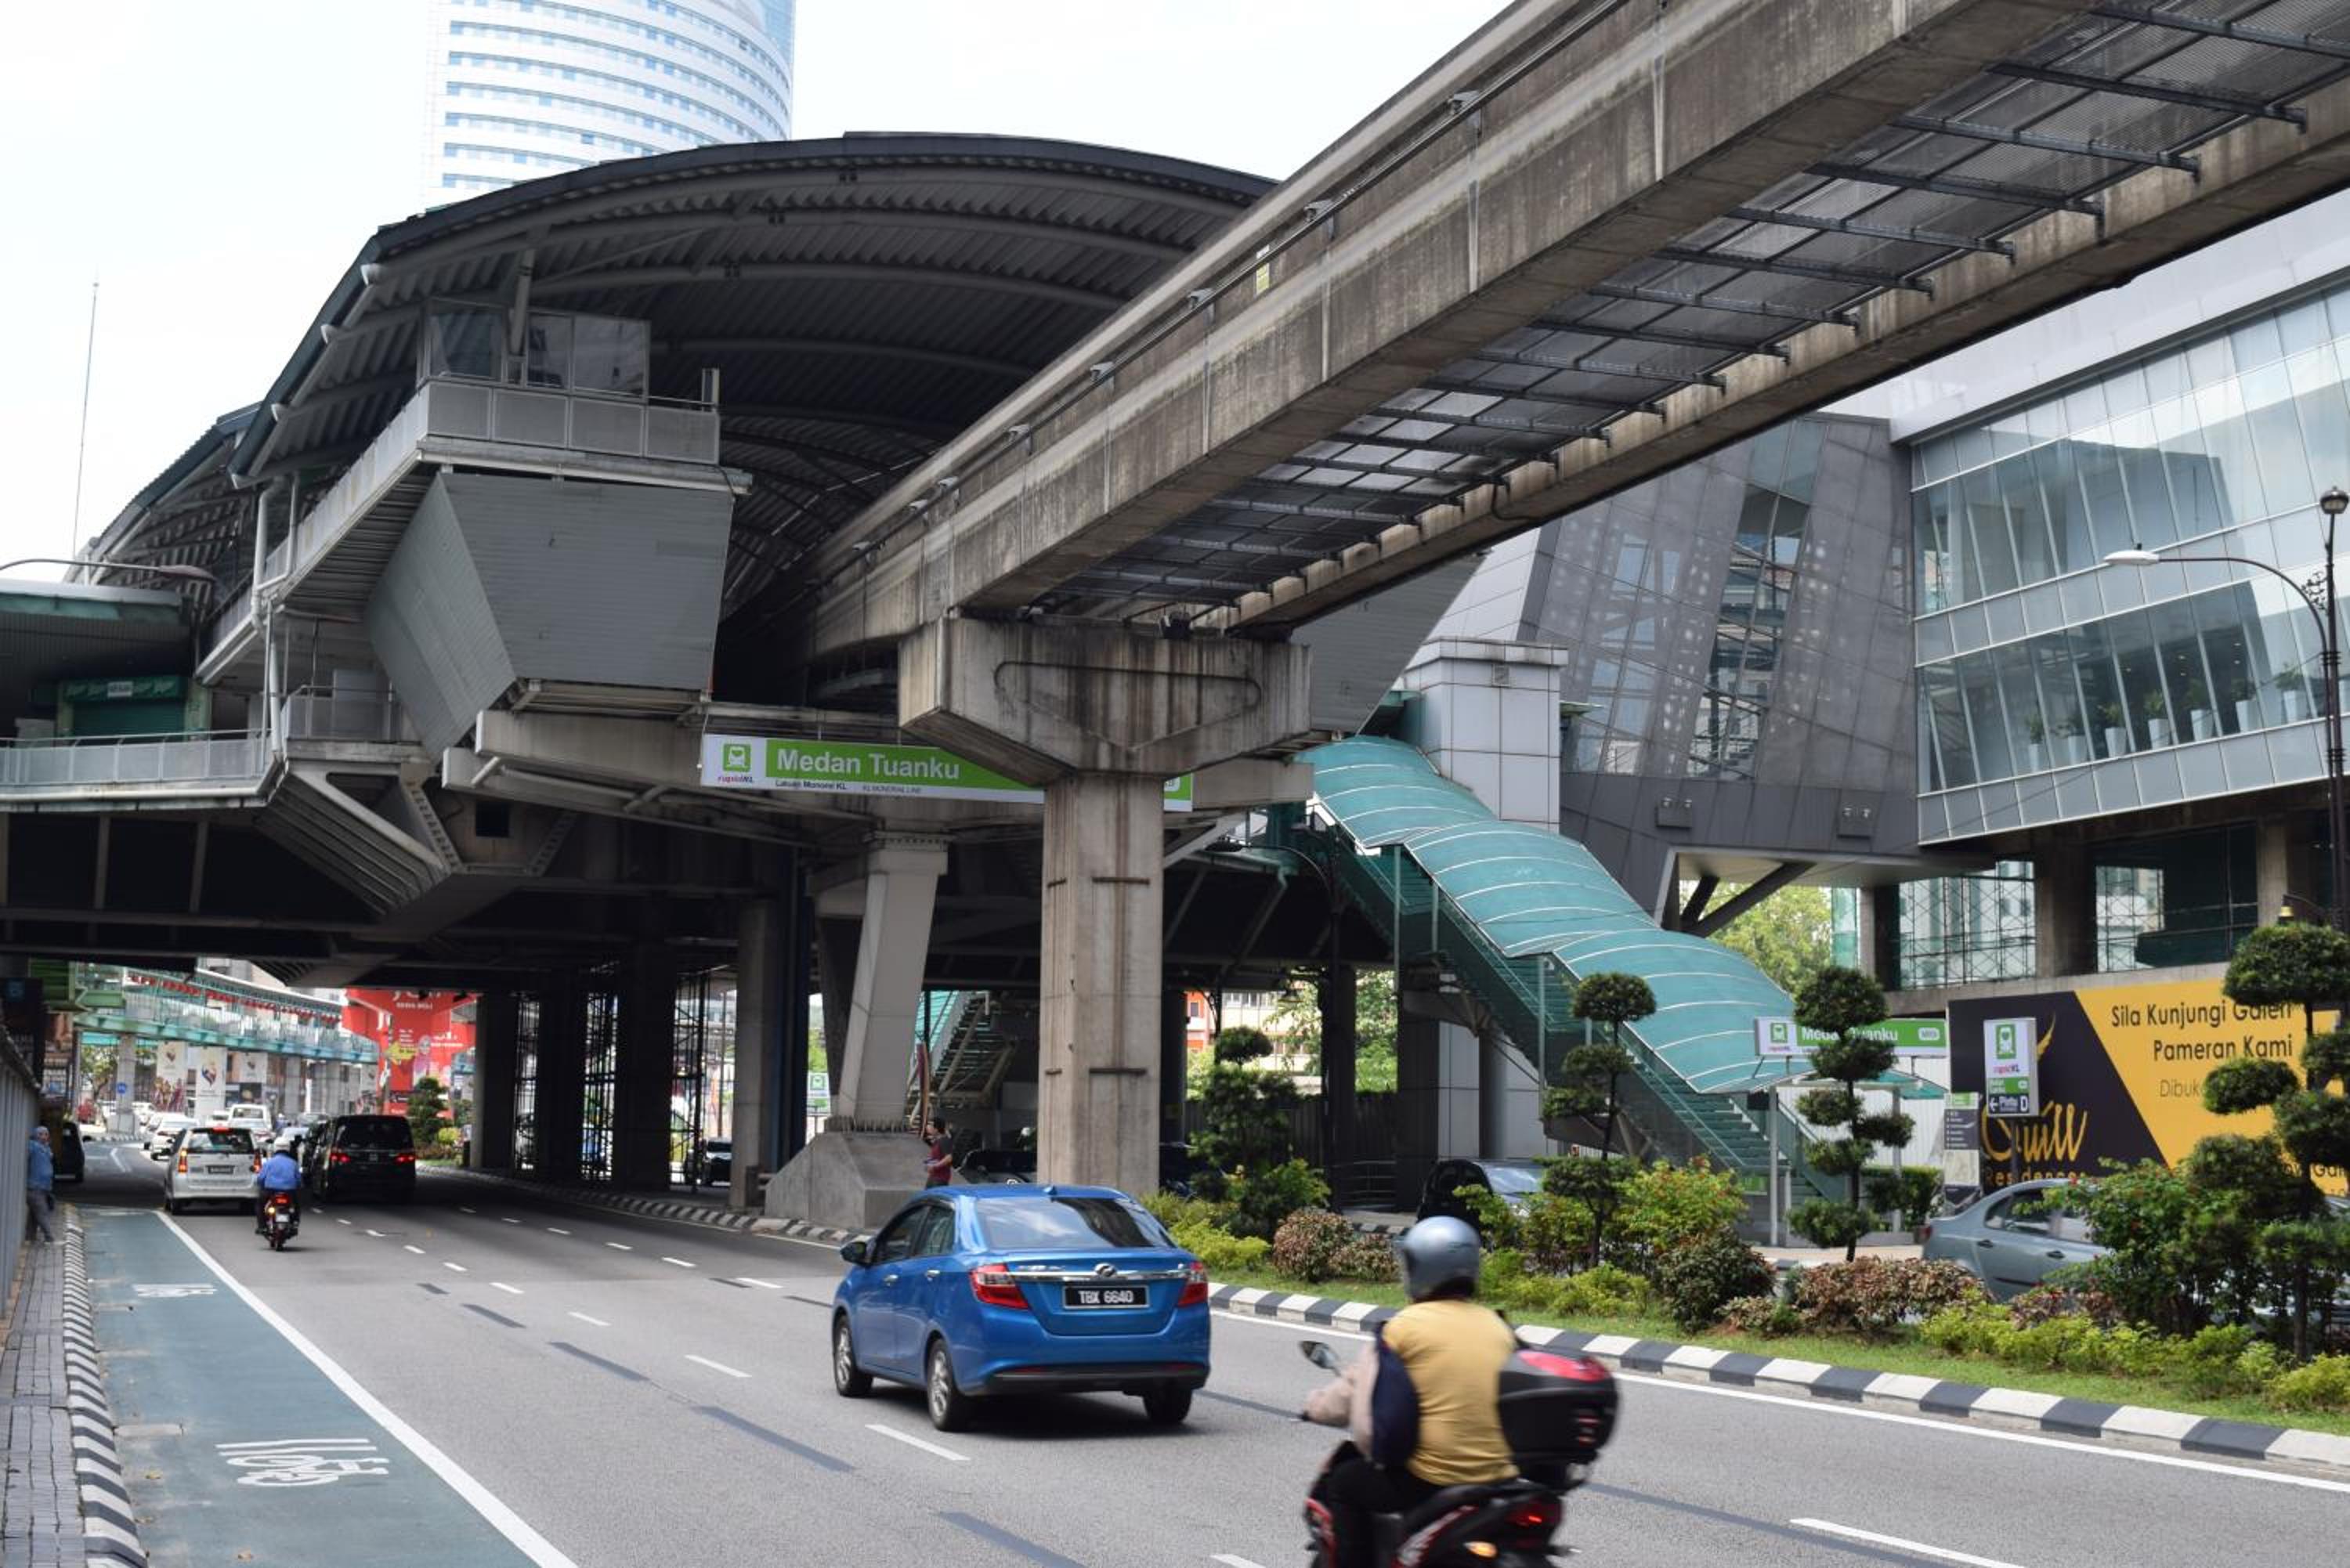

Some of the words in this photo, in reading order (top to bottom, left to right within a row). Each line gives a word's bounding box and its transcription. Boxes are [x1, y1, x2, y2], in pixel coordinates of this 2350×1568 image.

[776, 748, 860, 774] Medan
[868, 752, 959, 779] Tuanku
[2111, 1005, 2141, 1028] Sila
[2147, 999, 2225, 1029] Kunjungi
[2154, 1039, 2236, 1061] Pameran
[2243, 1033, 2293, 1058] Kami
[2160, 1078, 2200, 1098] Dibuk
